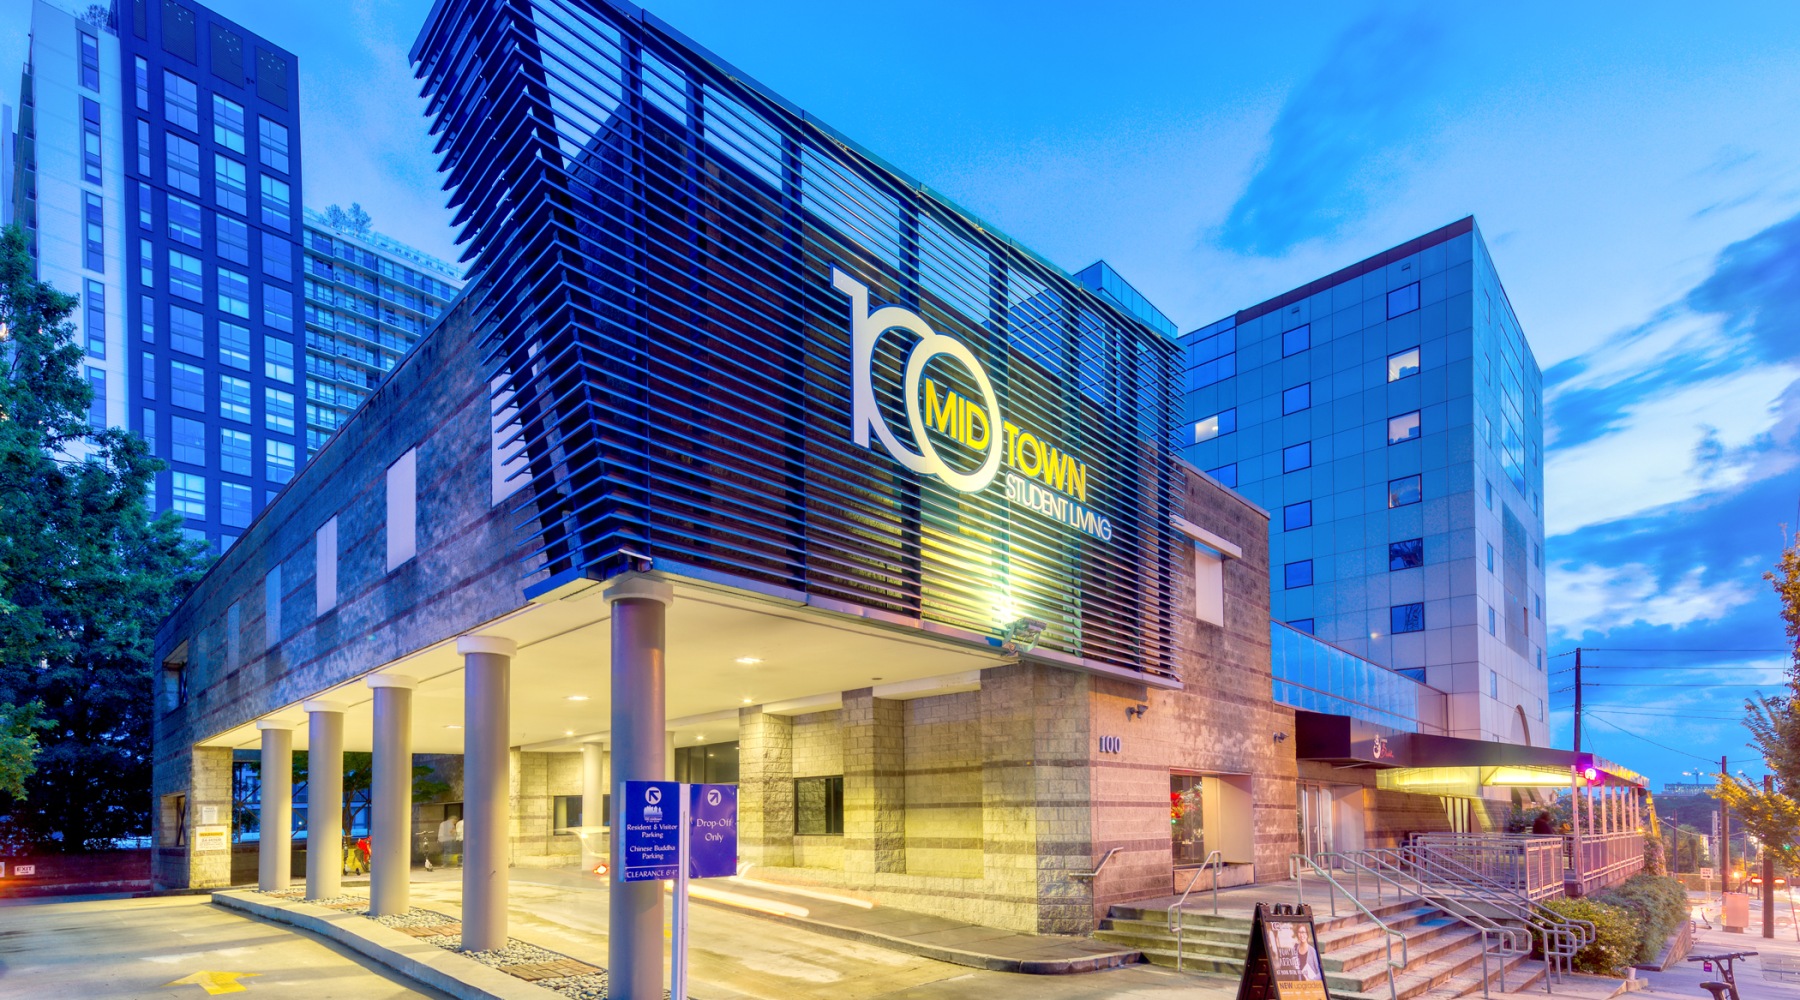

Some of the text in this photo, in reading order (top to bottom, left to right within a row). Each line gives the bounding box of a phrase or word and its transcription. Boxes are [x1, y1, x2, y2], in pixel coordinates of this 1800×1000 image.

[924, 378, 1086, 503] MID TOWN
[1006, 472, 1112, 541] STUDENT LIVING
[1099, 735, 1121, 753] 100
[697, 818, 732, 829] Drop-Off
[704, 832, 724, 843] Only
[626, 869, 665, 878] CLEARANCE
